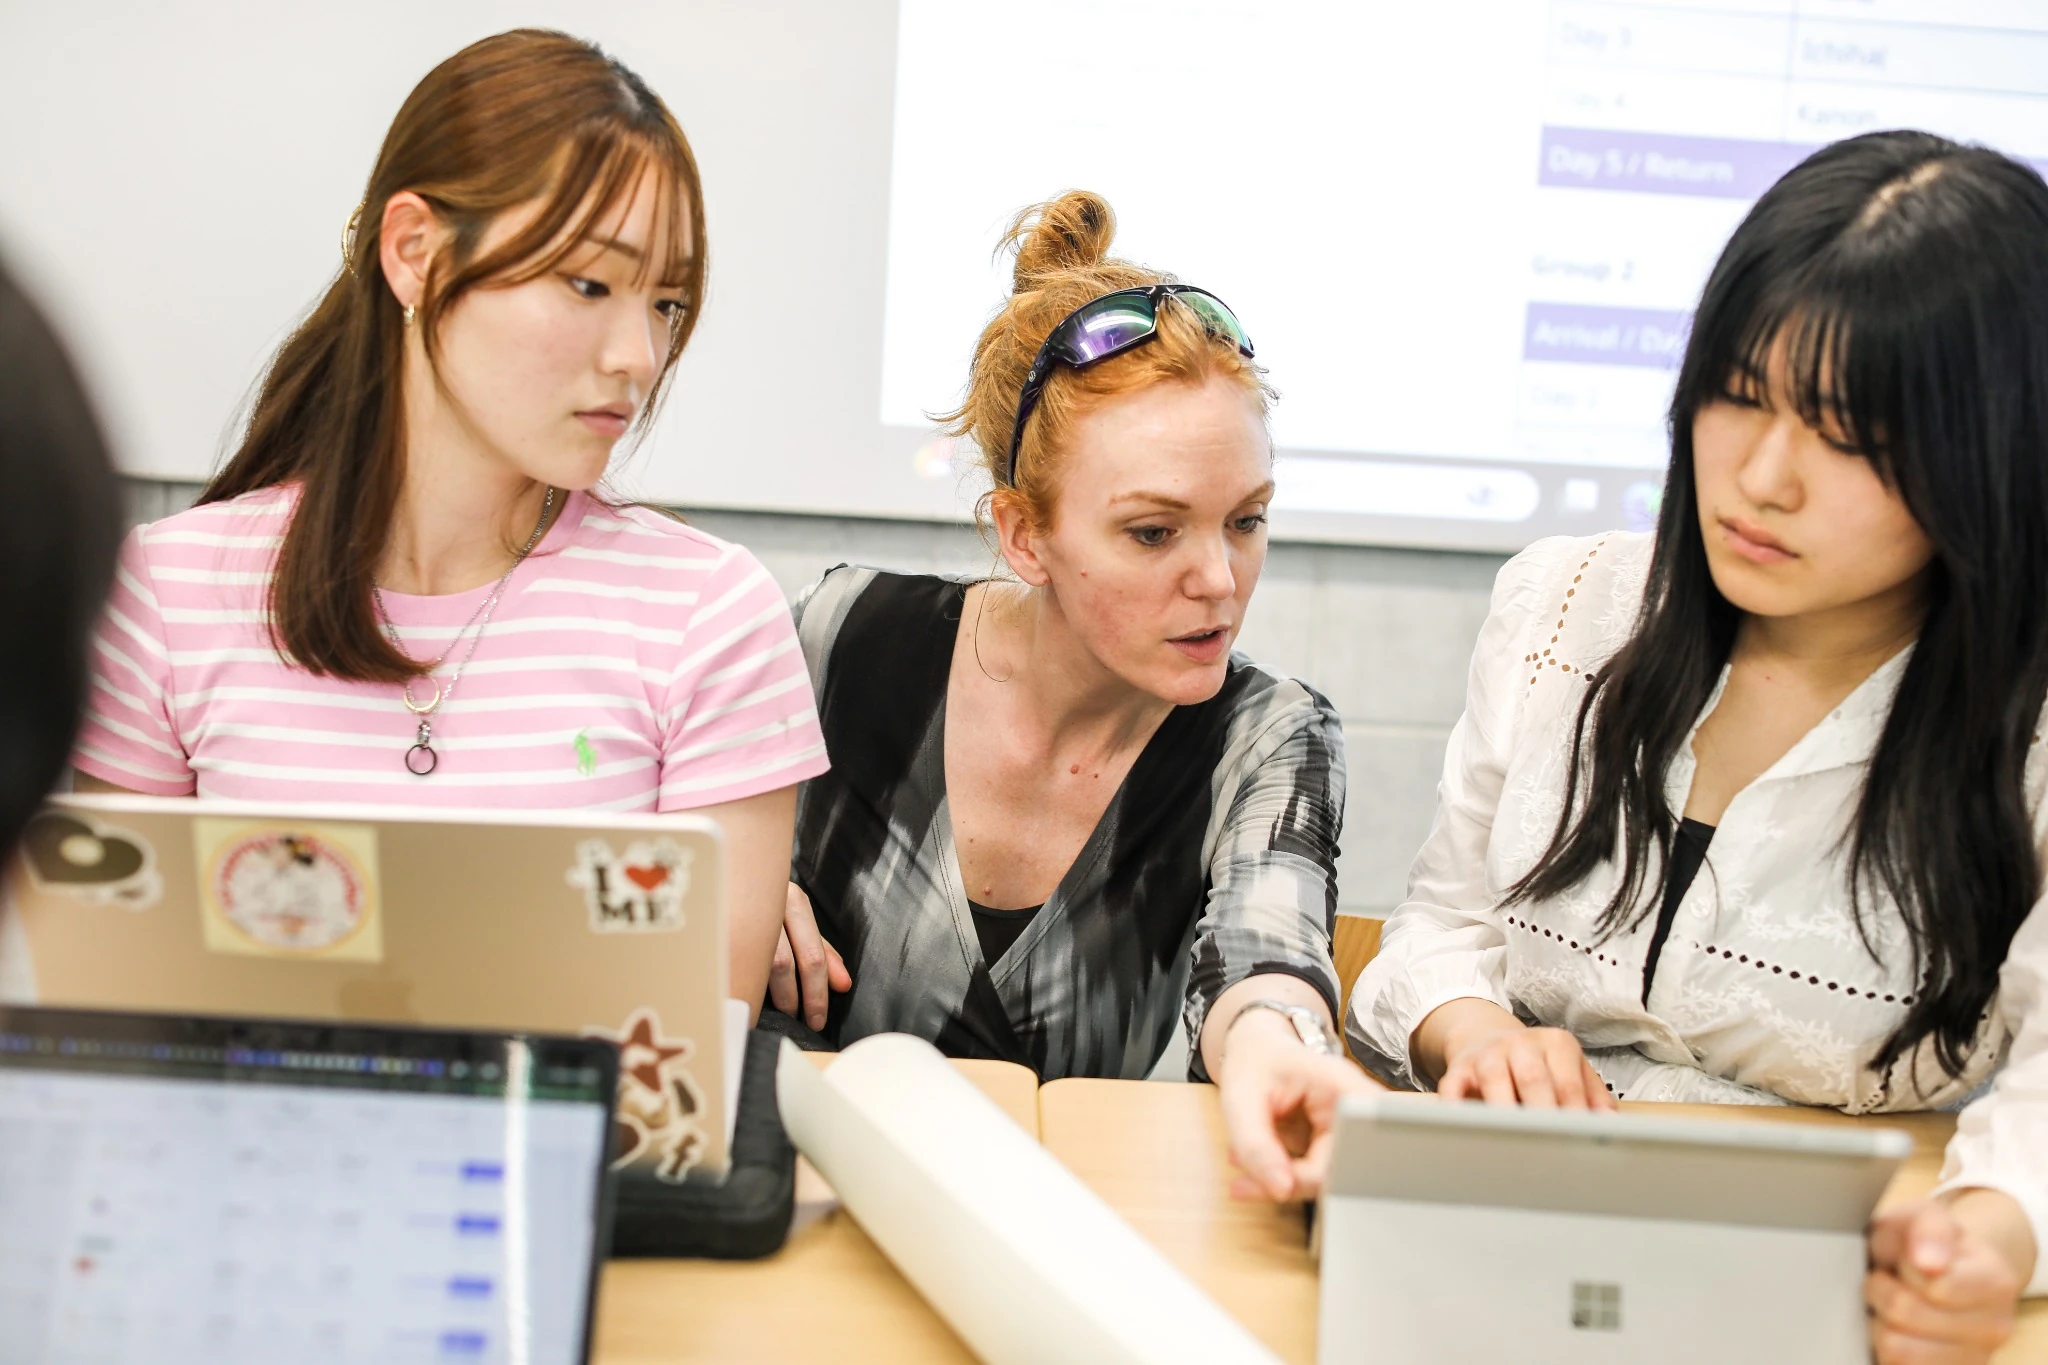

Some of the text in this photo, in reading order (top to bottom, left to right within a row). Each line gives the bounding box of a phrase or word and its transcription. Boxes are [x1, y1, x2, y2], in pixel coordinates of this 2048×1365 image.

[1548, 145, 1734, 183] Day 5 / Return
[1531, 255, 1612, 283] Group
[1533, 320, 1620, 350] Arrival
[1621, 326, 1637, 352] /
